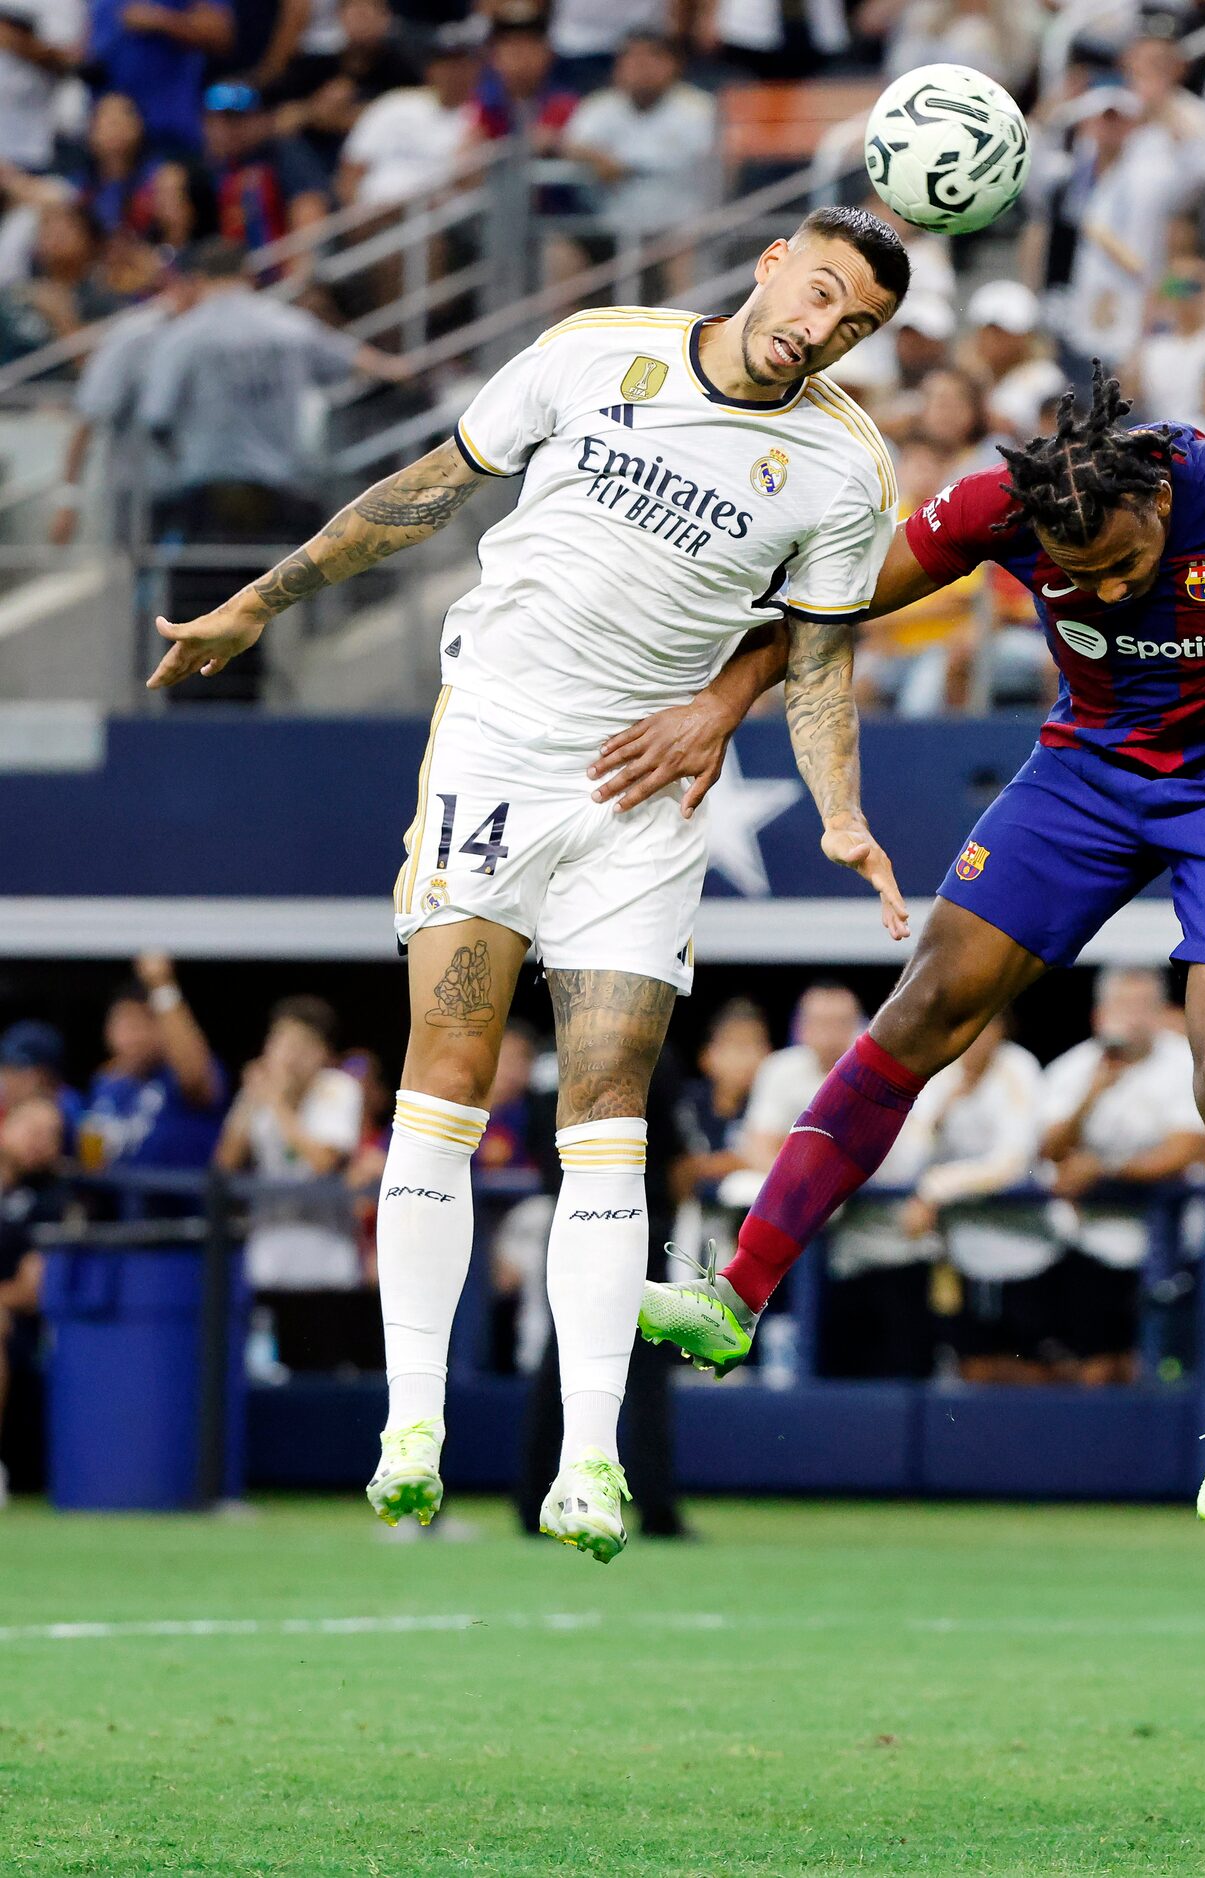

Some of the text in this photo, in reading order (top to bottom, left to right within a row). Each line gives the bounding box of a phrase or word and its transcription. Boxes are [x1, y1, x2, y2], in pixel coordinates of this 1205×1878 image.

[577, 436, 753, 539] Emirates
[586, 474, 712, 558] FLY BETTER
[436, 793, 510, 876] 14
[385, 1186, 456, 1202] RMCF
[569, 1209, 643, 1221] RMCF
